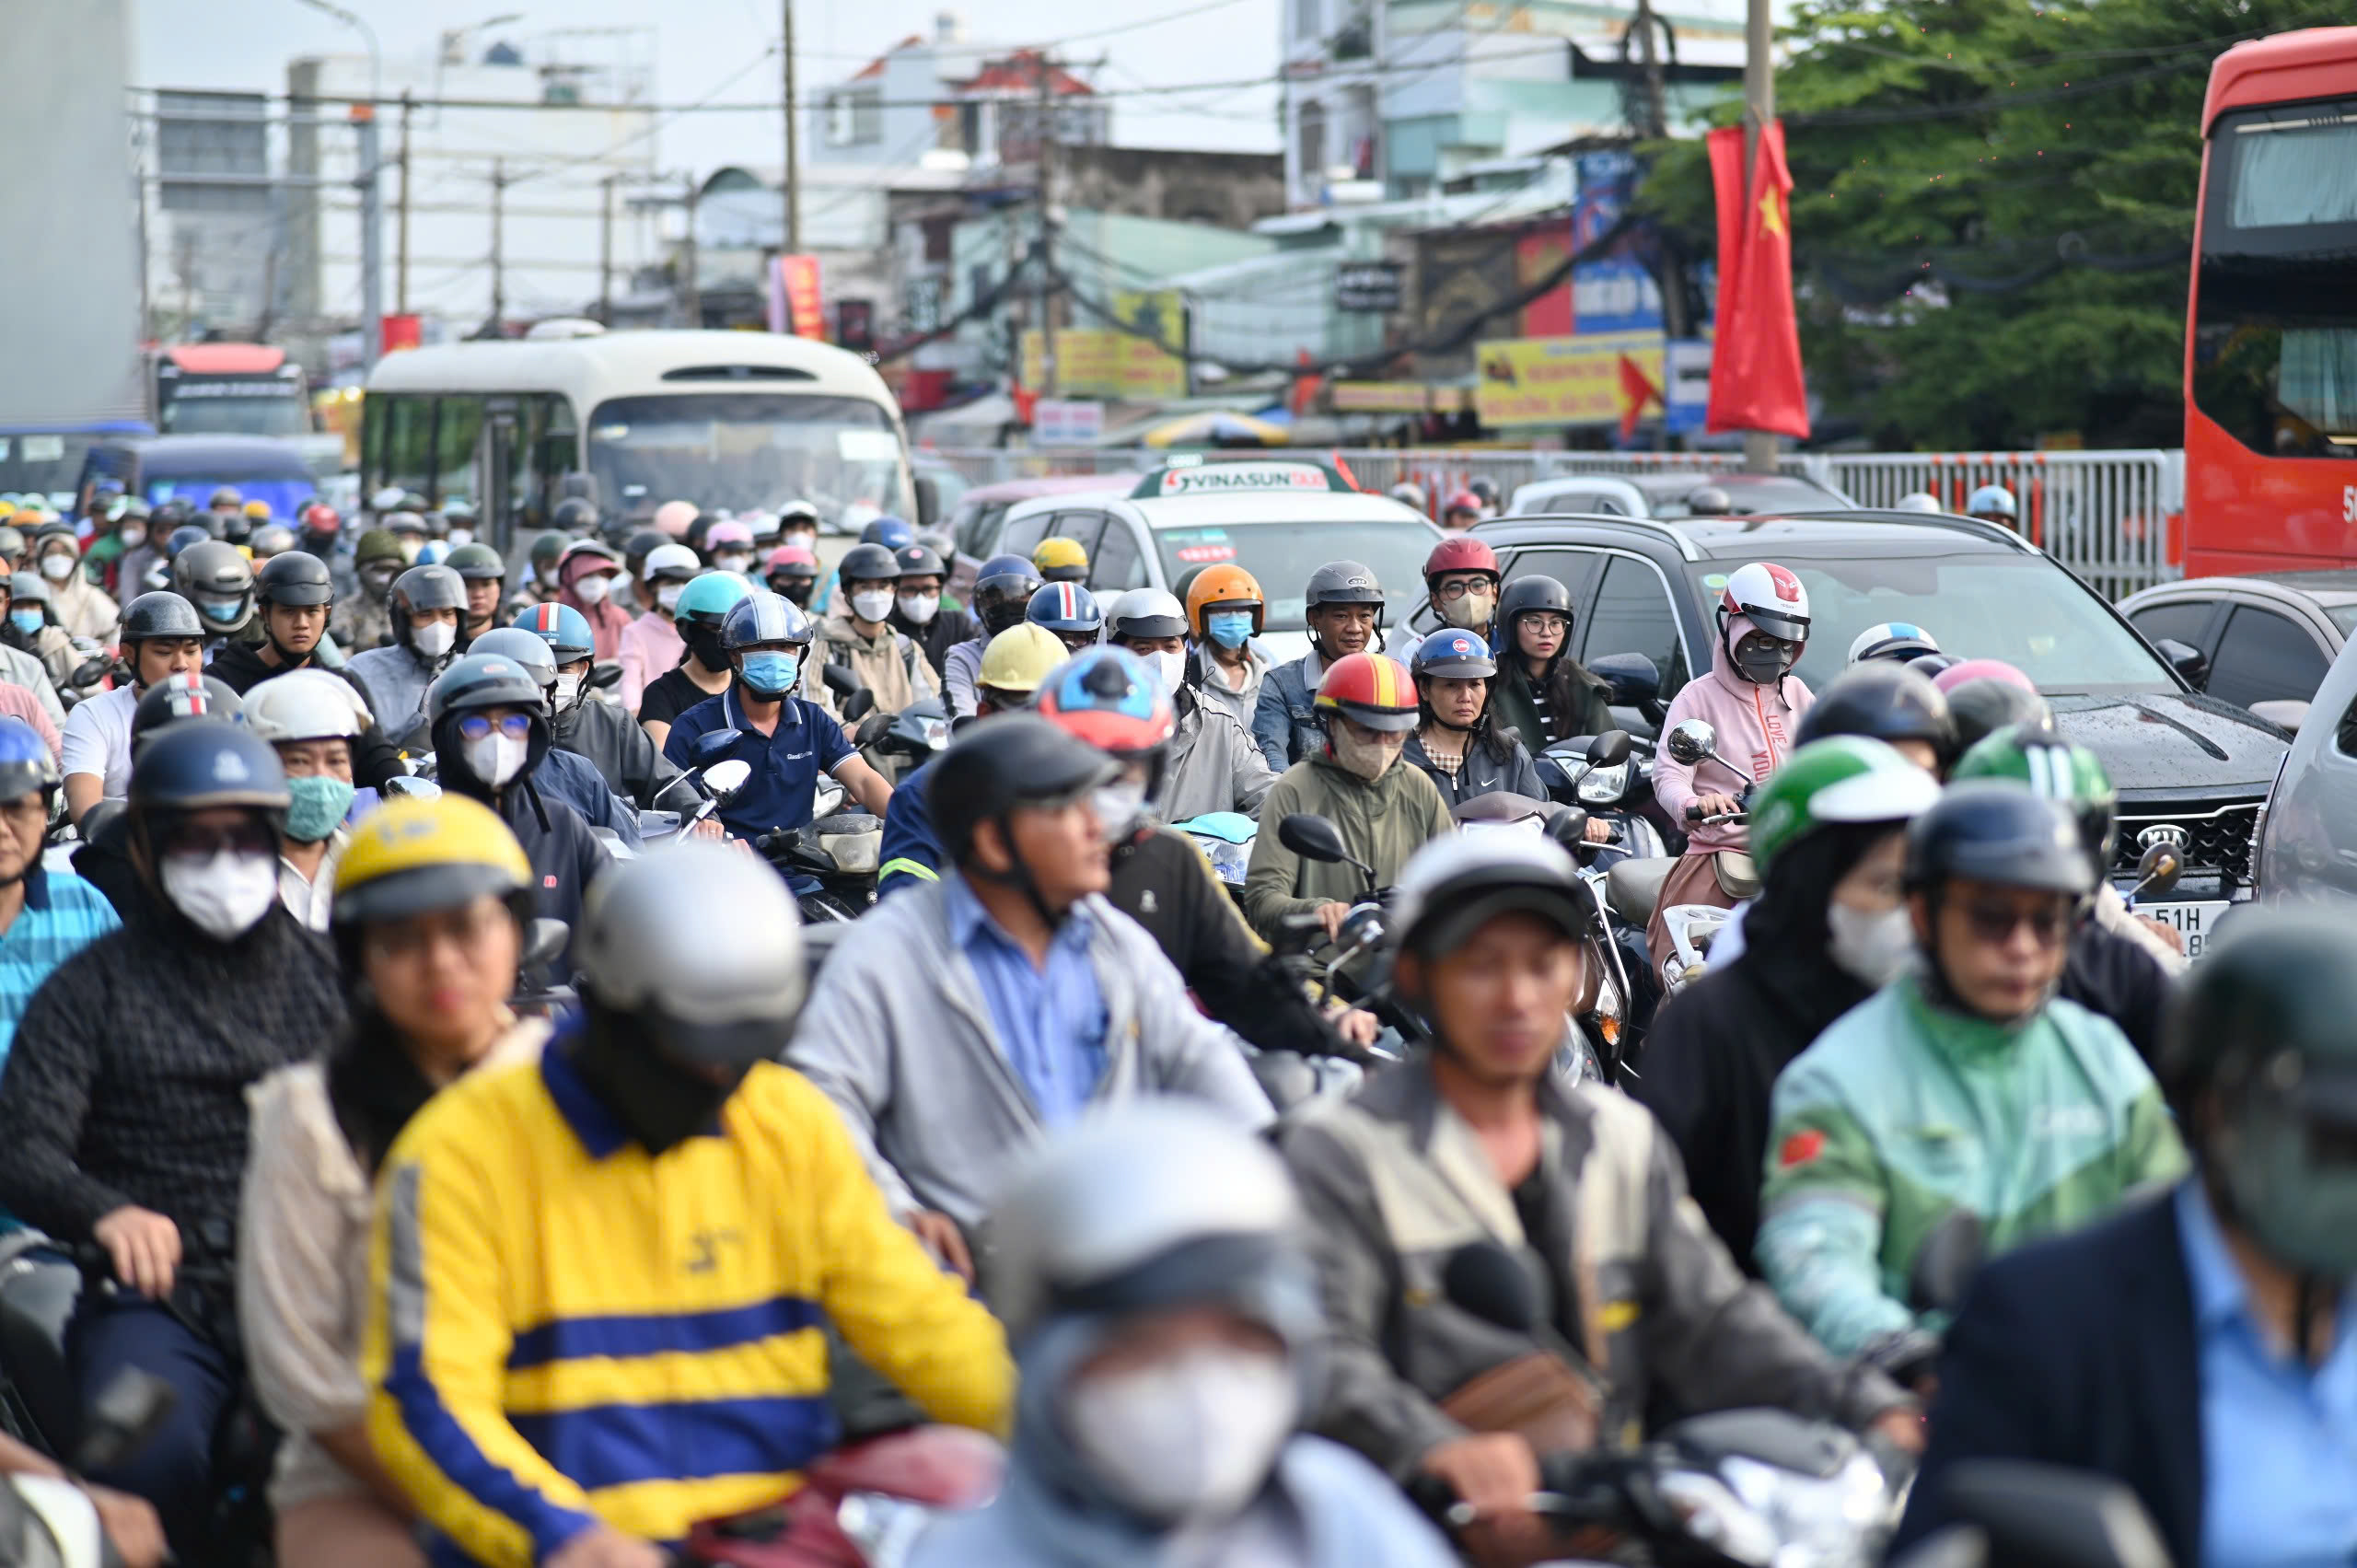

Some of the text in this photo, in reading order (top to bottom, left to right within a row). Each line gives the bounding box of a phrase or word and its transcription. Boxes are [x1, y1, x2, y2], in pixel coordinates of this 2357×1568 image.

[1195, 470, 1290, 487] VINASUN
[2343, 485, 2357, 523] 5
[1766, 714, 1787, 744] LOVE
[2147, 830, 2183, 849] KIA
[2155, 908, 2200, 931] 51H
